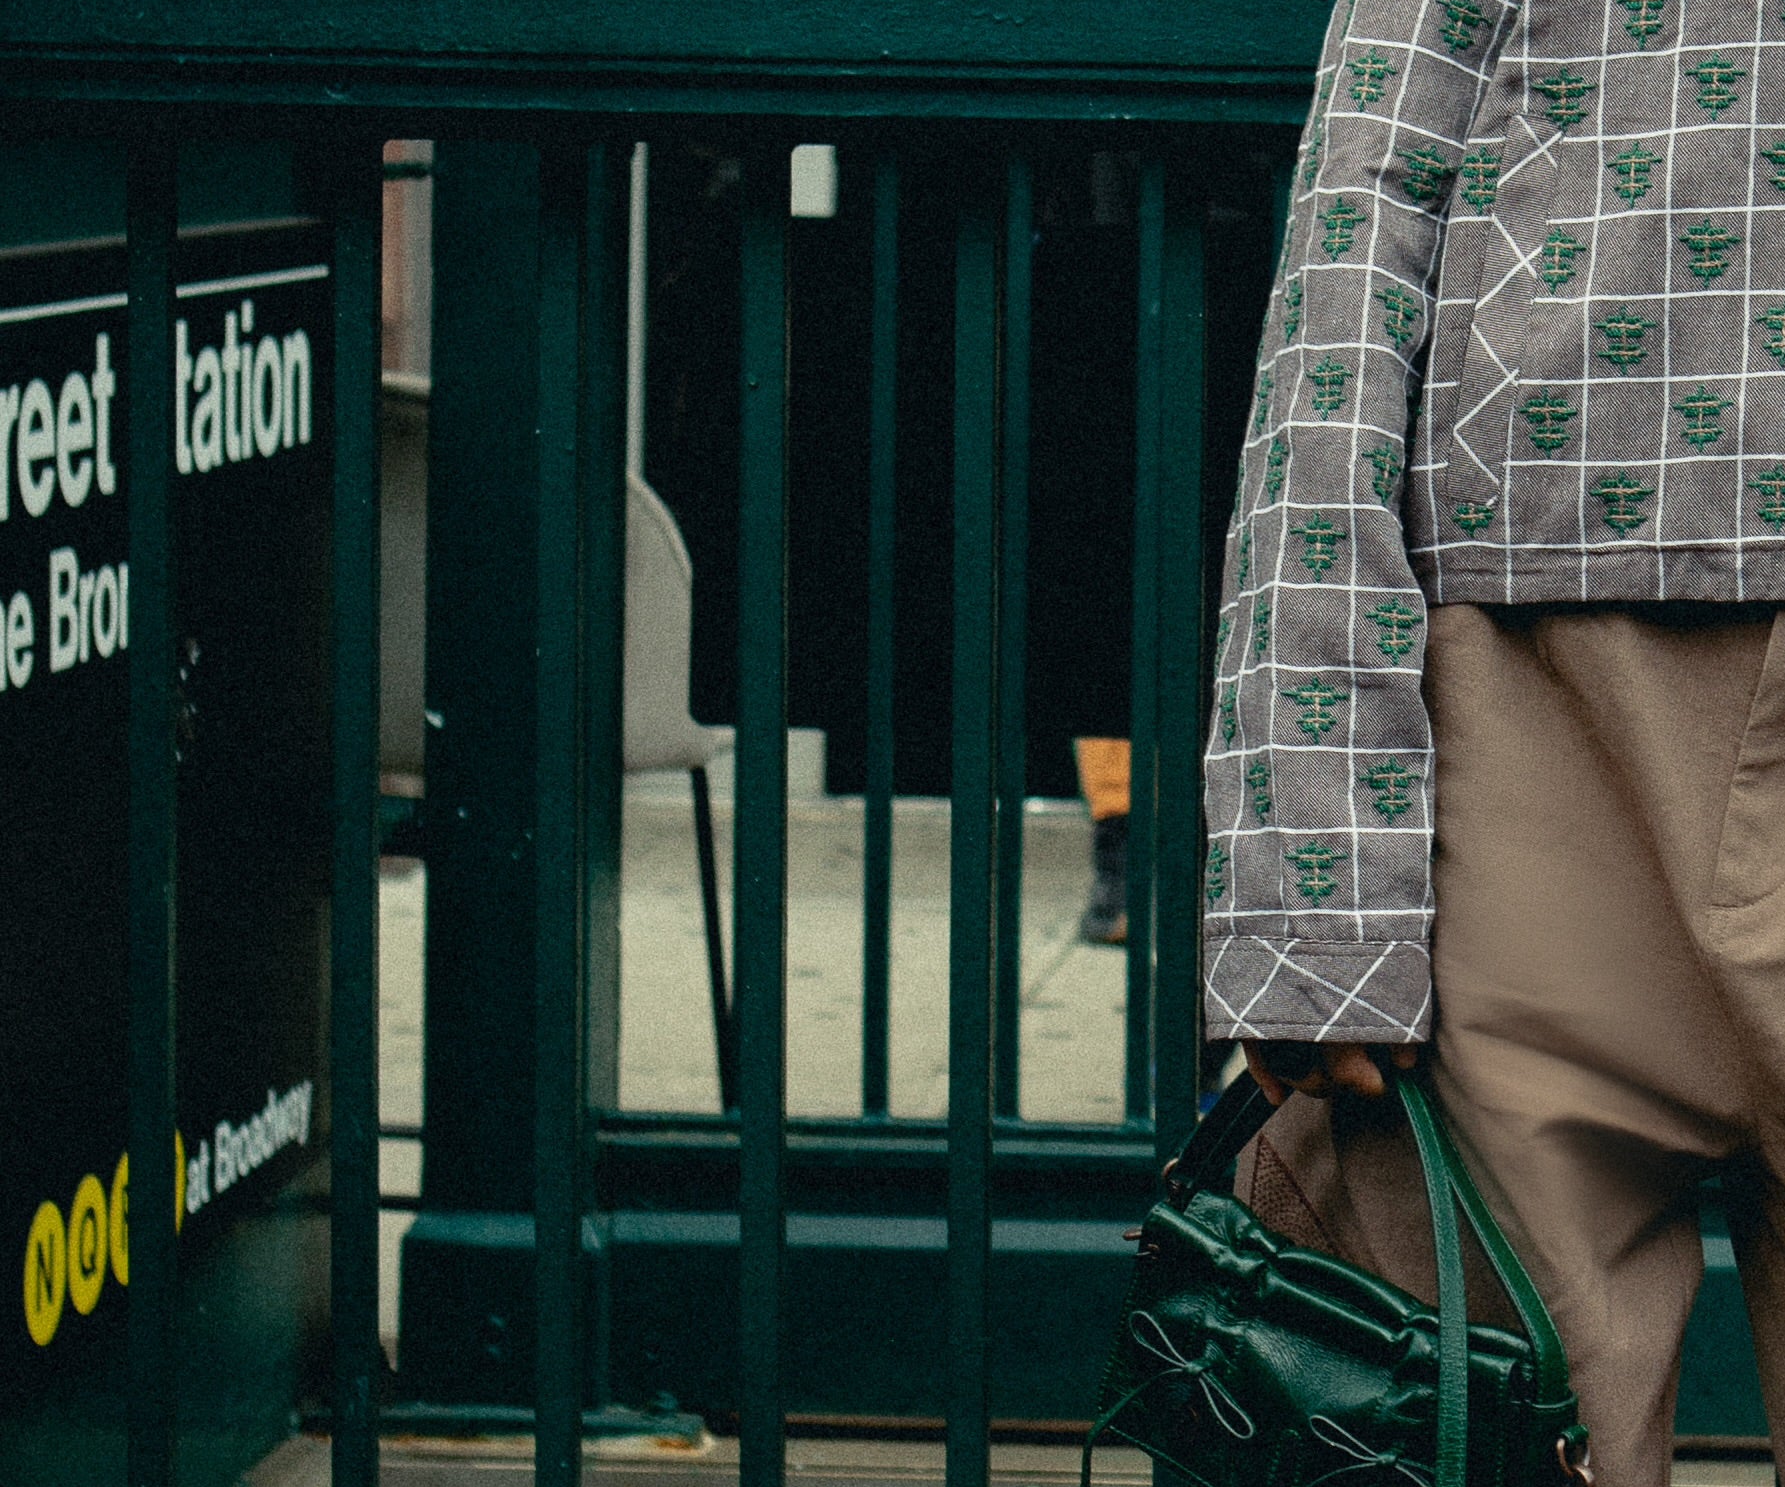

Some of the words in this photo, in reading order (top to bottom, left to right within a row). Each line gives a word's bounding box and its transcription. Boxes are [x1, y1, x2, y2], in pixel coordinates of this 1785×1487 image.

[176, 298, 312, 475] tation
[187, 1138, 210, 1214] at
[214, 1079, 313, 1194] Broadway
